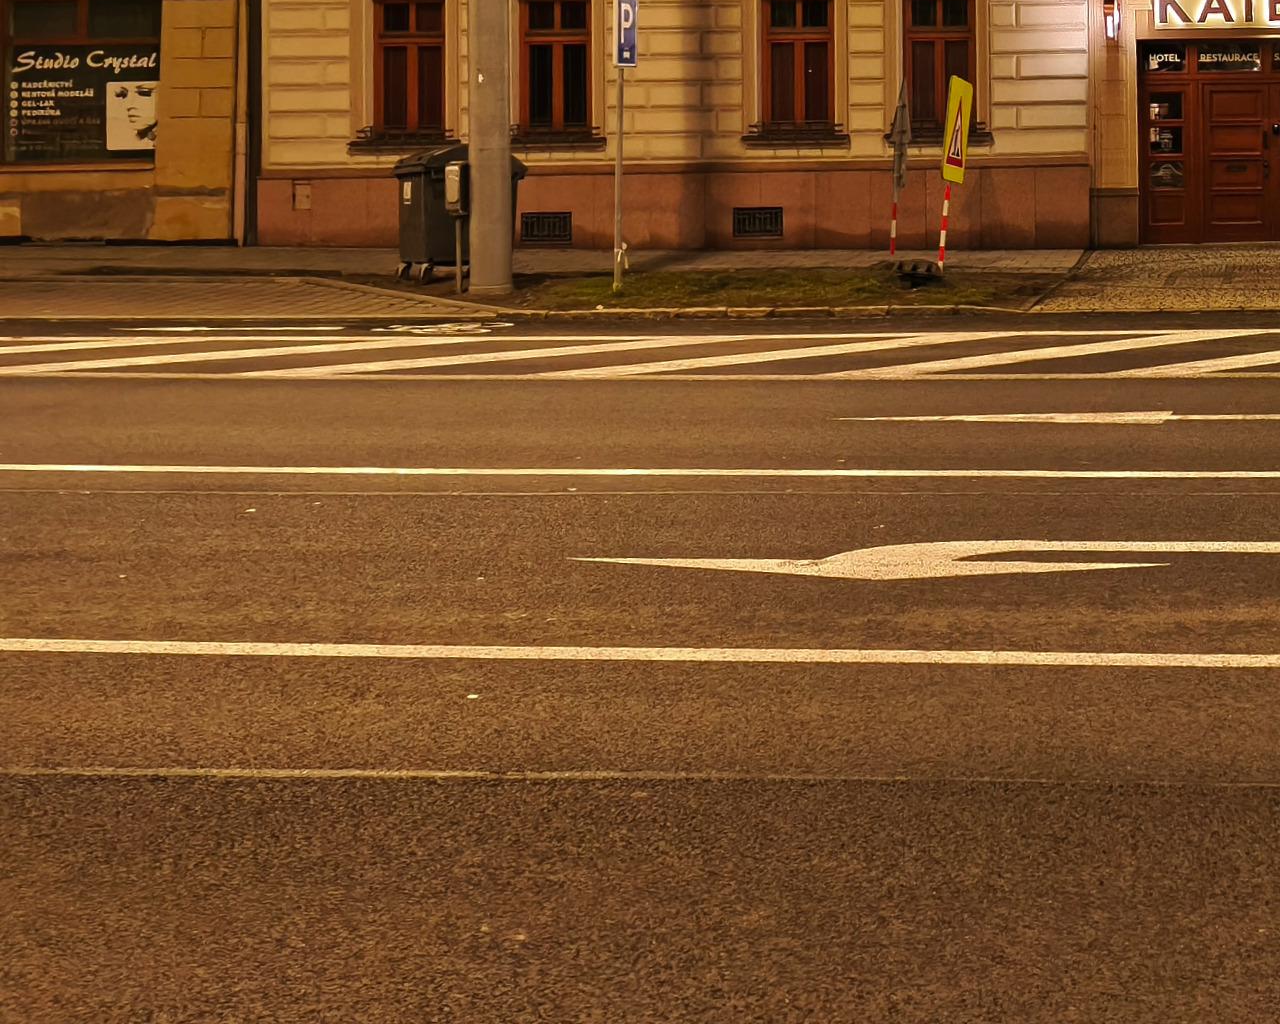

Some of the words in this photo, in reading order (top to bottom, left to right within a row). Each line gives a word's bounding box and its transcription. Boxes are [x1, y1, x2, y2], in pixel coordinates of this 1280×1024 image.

[620, 3, 633, 44] P
[12, 51, 80, 73] Studio
[86, 50, 157, 74] Crystal
[1149, 53, 1181, 62] HOTEL
[1199, 53, 1260, 62] RESTAURACE
